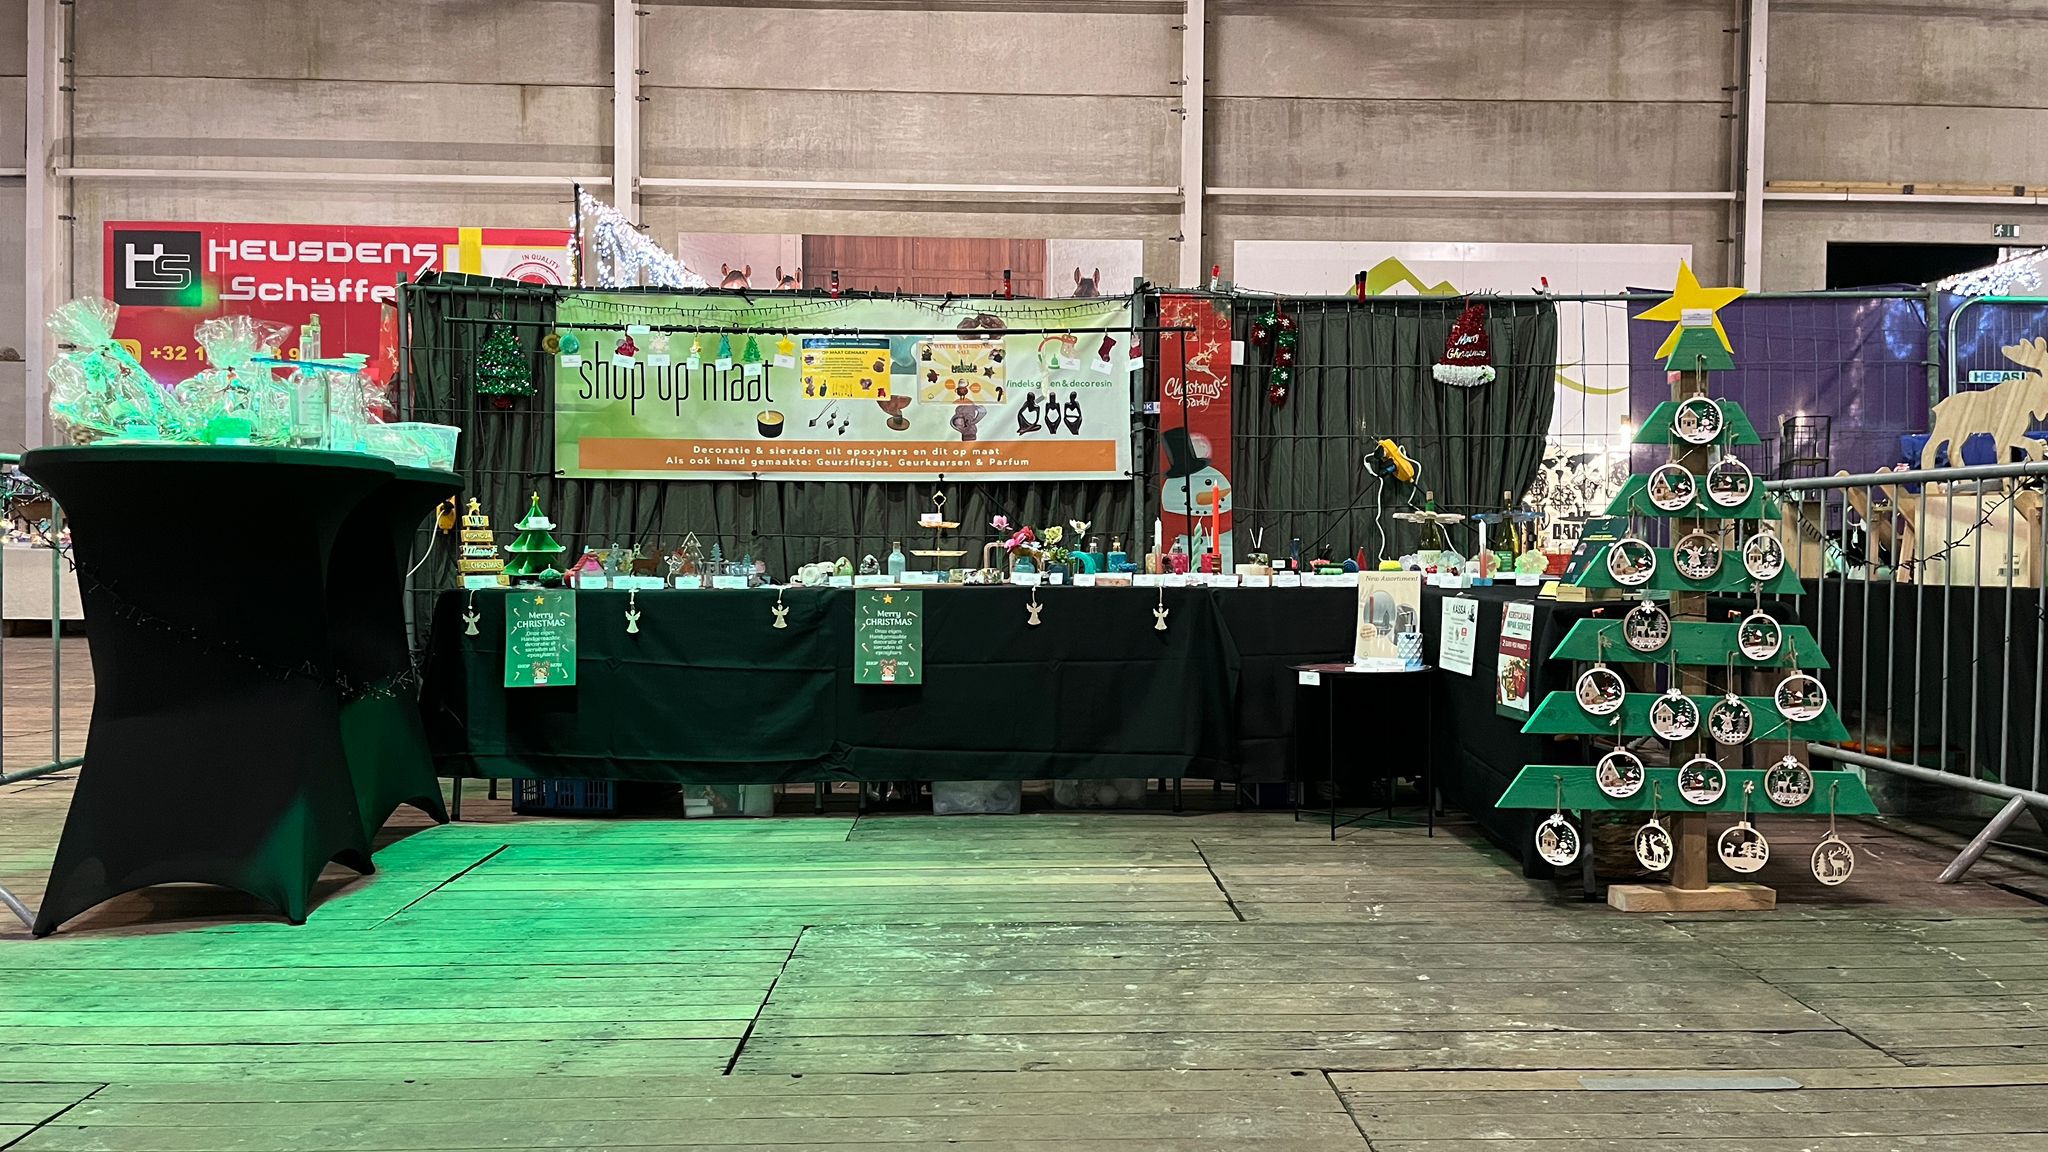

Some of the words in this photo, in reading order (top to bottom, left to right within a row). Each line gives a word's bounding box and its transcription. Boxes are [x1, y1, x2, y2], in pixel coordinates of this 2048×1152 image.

[208, 239, 438, 276] HEUSDENS
[531, 254, 560, 270] QUALITY
[219, 276, 397, 303] Schäffe
[150, 345, 188, 361] +32
[579, 341, 645, 416] shop
[658, 361, 689, 417] op
[703, 360, 774, 403] maat
[1035, 380, 1061, 389] gen
[1062, 379, 1069, 388] &
[693, 445, 751, 455] Decoratie
[756, 446, 764, 455] &
[769, 446, 820, 455] sieraden
[826, 446, 841, 455] uit
[847, 447, 908, 458] epoxyhars
[932, 447, 948, 456] dit
[953, 449, 967, 458] op
[972, 447, 1000, 456] maat
[666, 456, 684, 465] Als
[689, 456, 711, 465] ook
[716, 456, 746, 465] hand
[751, 457, 811, 467] gemaakte:
[816, 458, 893, 468] Geursflesjes,
[898, 458, 971, 467] Geurkaarsen
[989, 458, 1030, 467] Parfum
[528, 611, 554, 620] Merry
[877, 610, 901, 619] Merry
[516, 619, 566, 628] CHRISTMAS
[865, 618, 913, 626] CHRISTMAS
